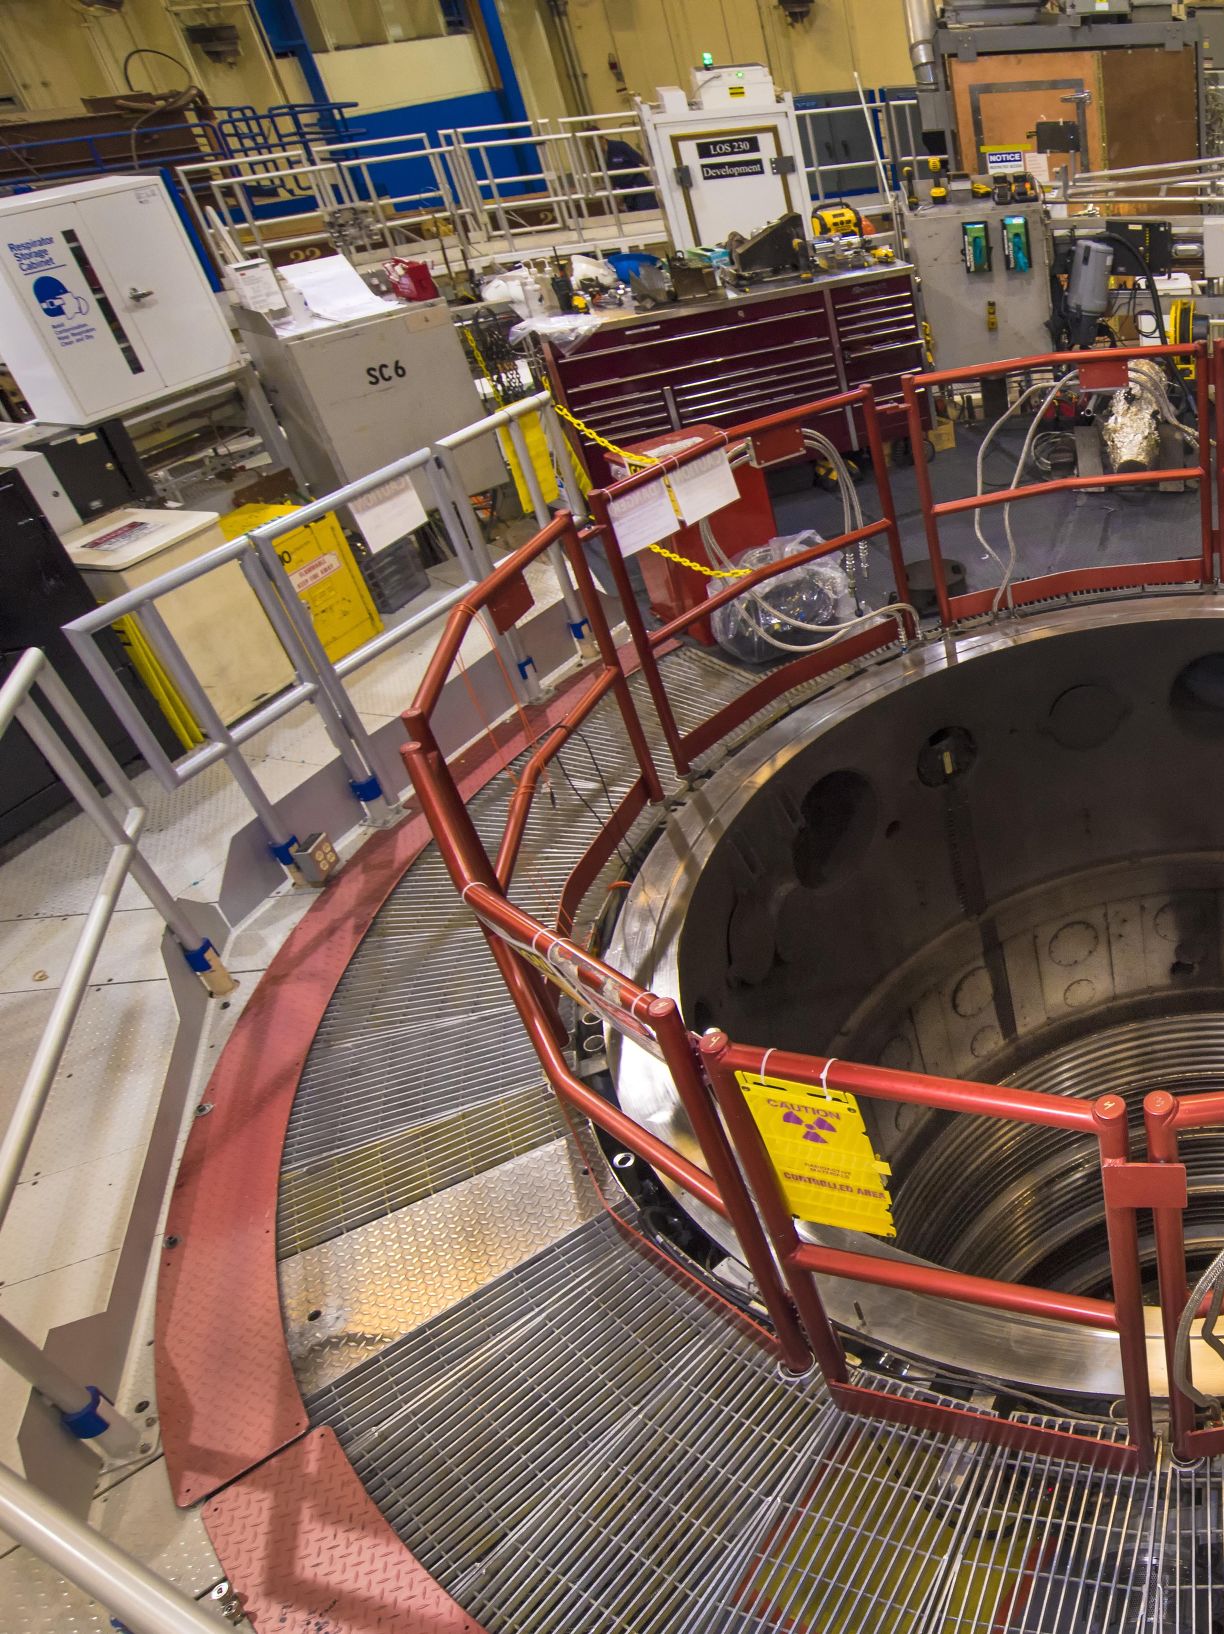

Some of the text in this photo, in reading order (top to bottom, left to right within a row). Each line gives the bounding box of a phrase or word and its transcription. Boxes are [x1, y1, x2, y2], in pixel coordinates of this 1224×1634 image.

[709, 141, 750, 154] LOS 230
[989, 153, 1021, 162] NOTICE
[703, 164, 762, 177] Development
[8, 236, 54, 254] Respirator
[14, 248, 49, 262] Storage
[19, 257, 56, 272] Cabinet
[366, 360, 406, 385] SC 6
[767, 1098, 841, 1120] CAUTION
[783, 1171, 887, 1200] CONTROLLED AREA
